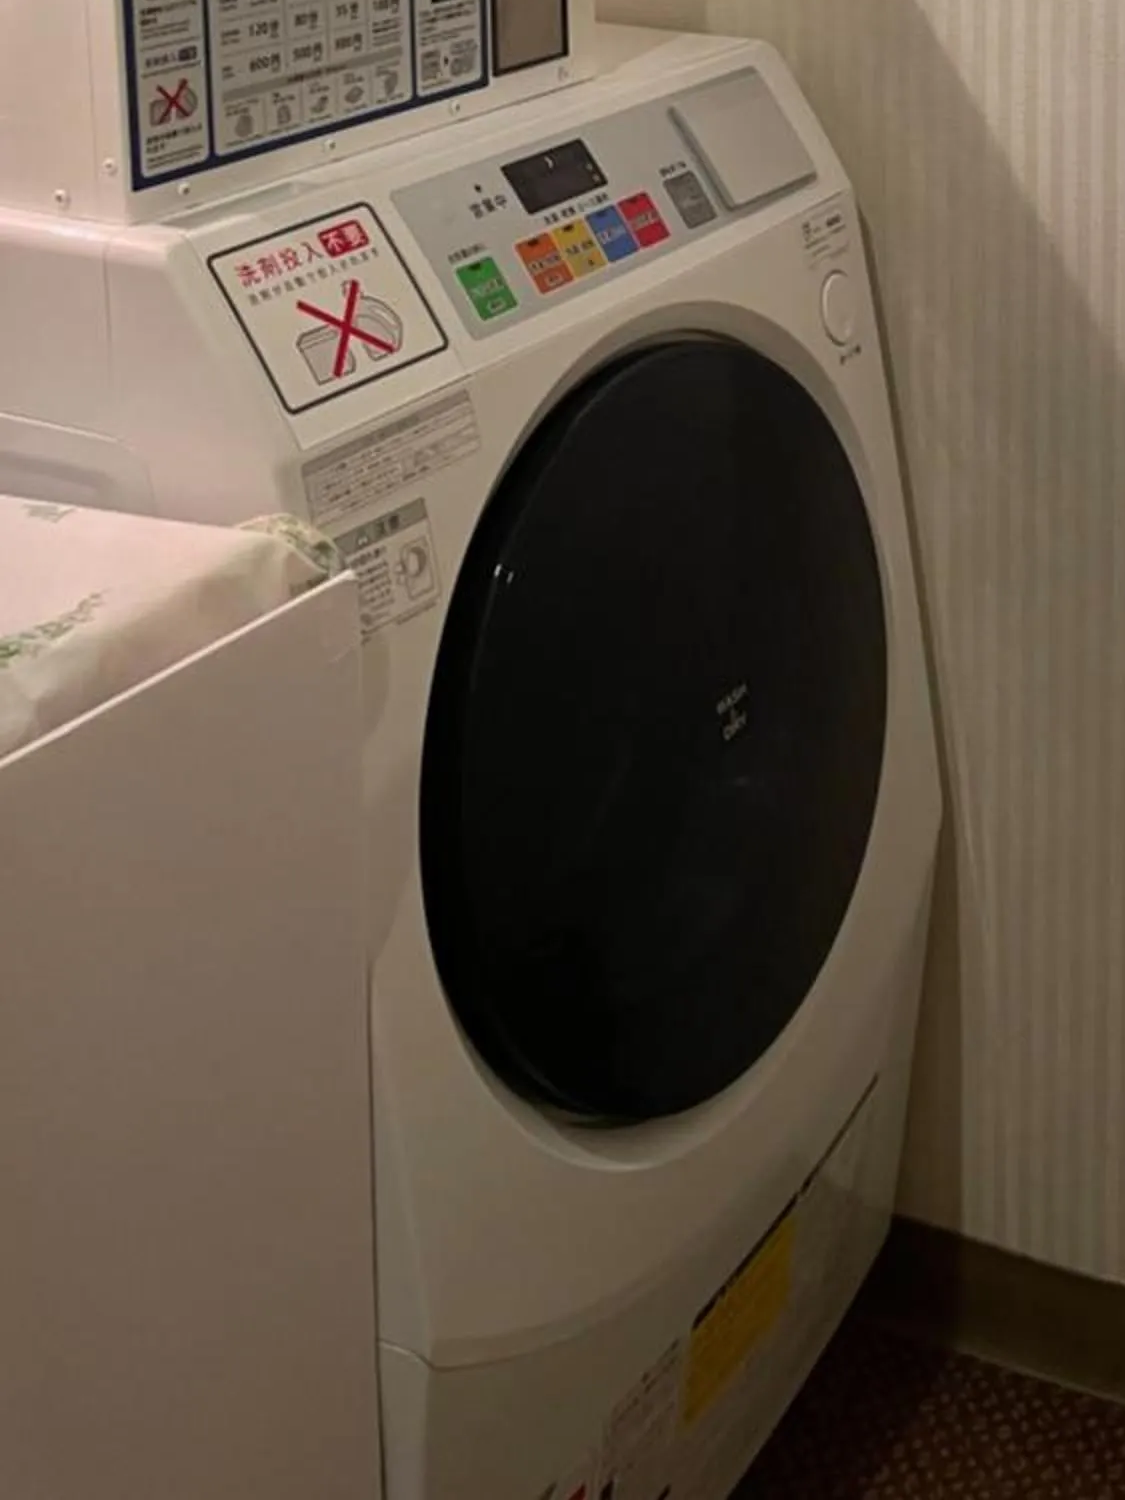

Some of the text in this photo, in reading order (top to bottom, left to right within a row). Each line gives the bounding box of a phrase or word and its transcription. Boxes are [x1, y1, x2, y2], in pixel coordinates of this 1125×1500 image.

[234, 222, 365, 289] 洗剤投入 不要
